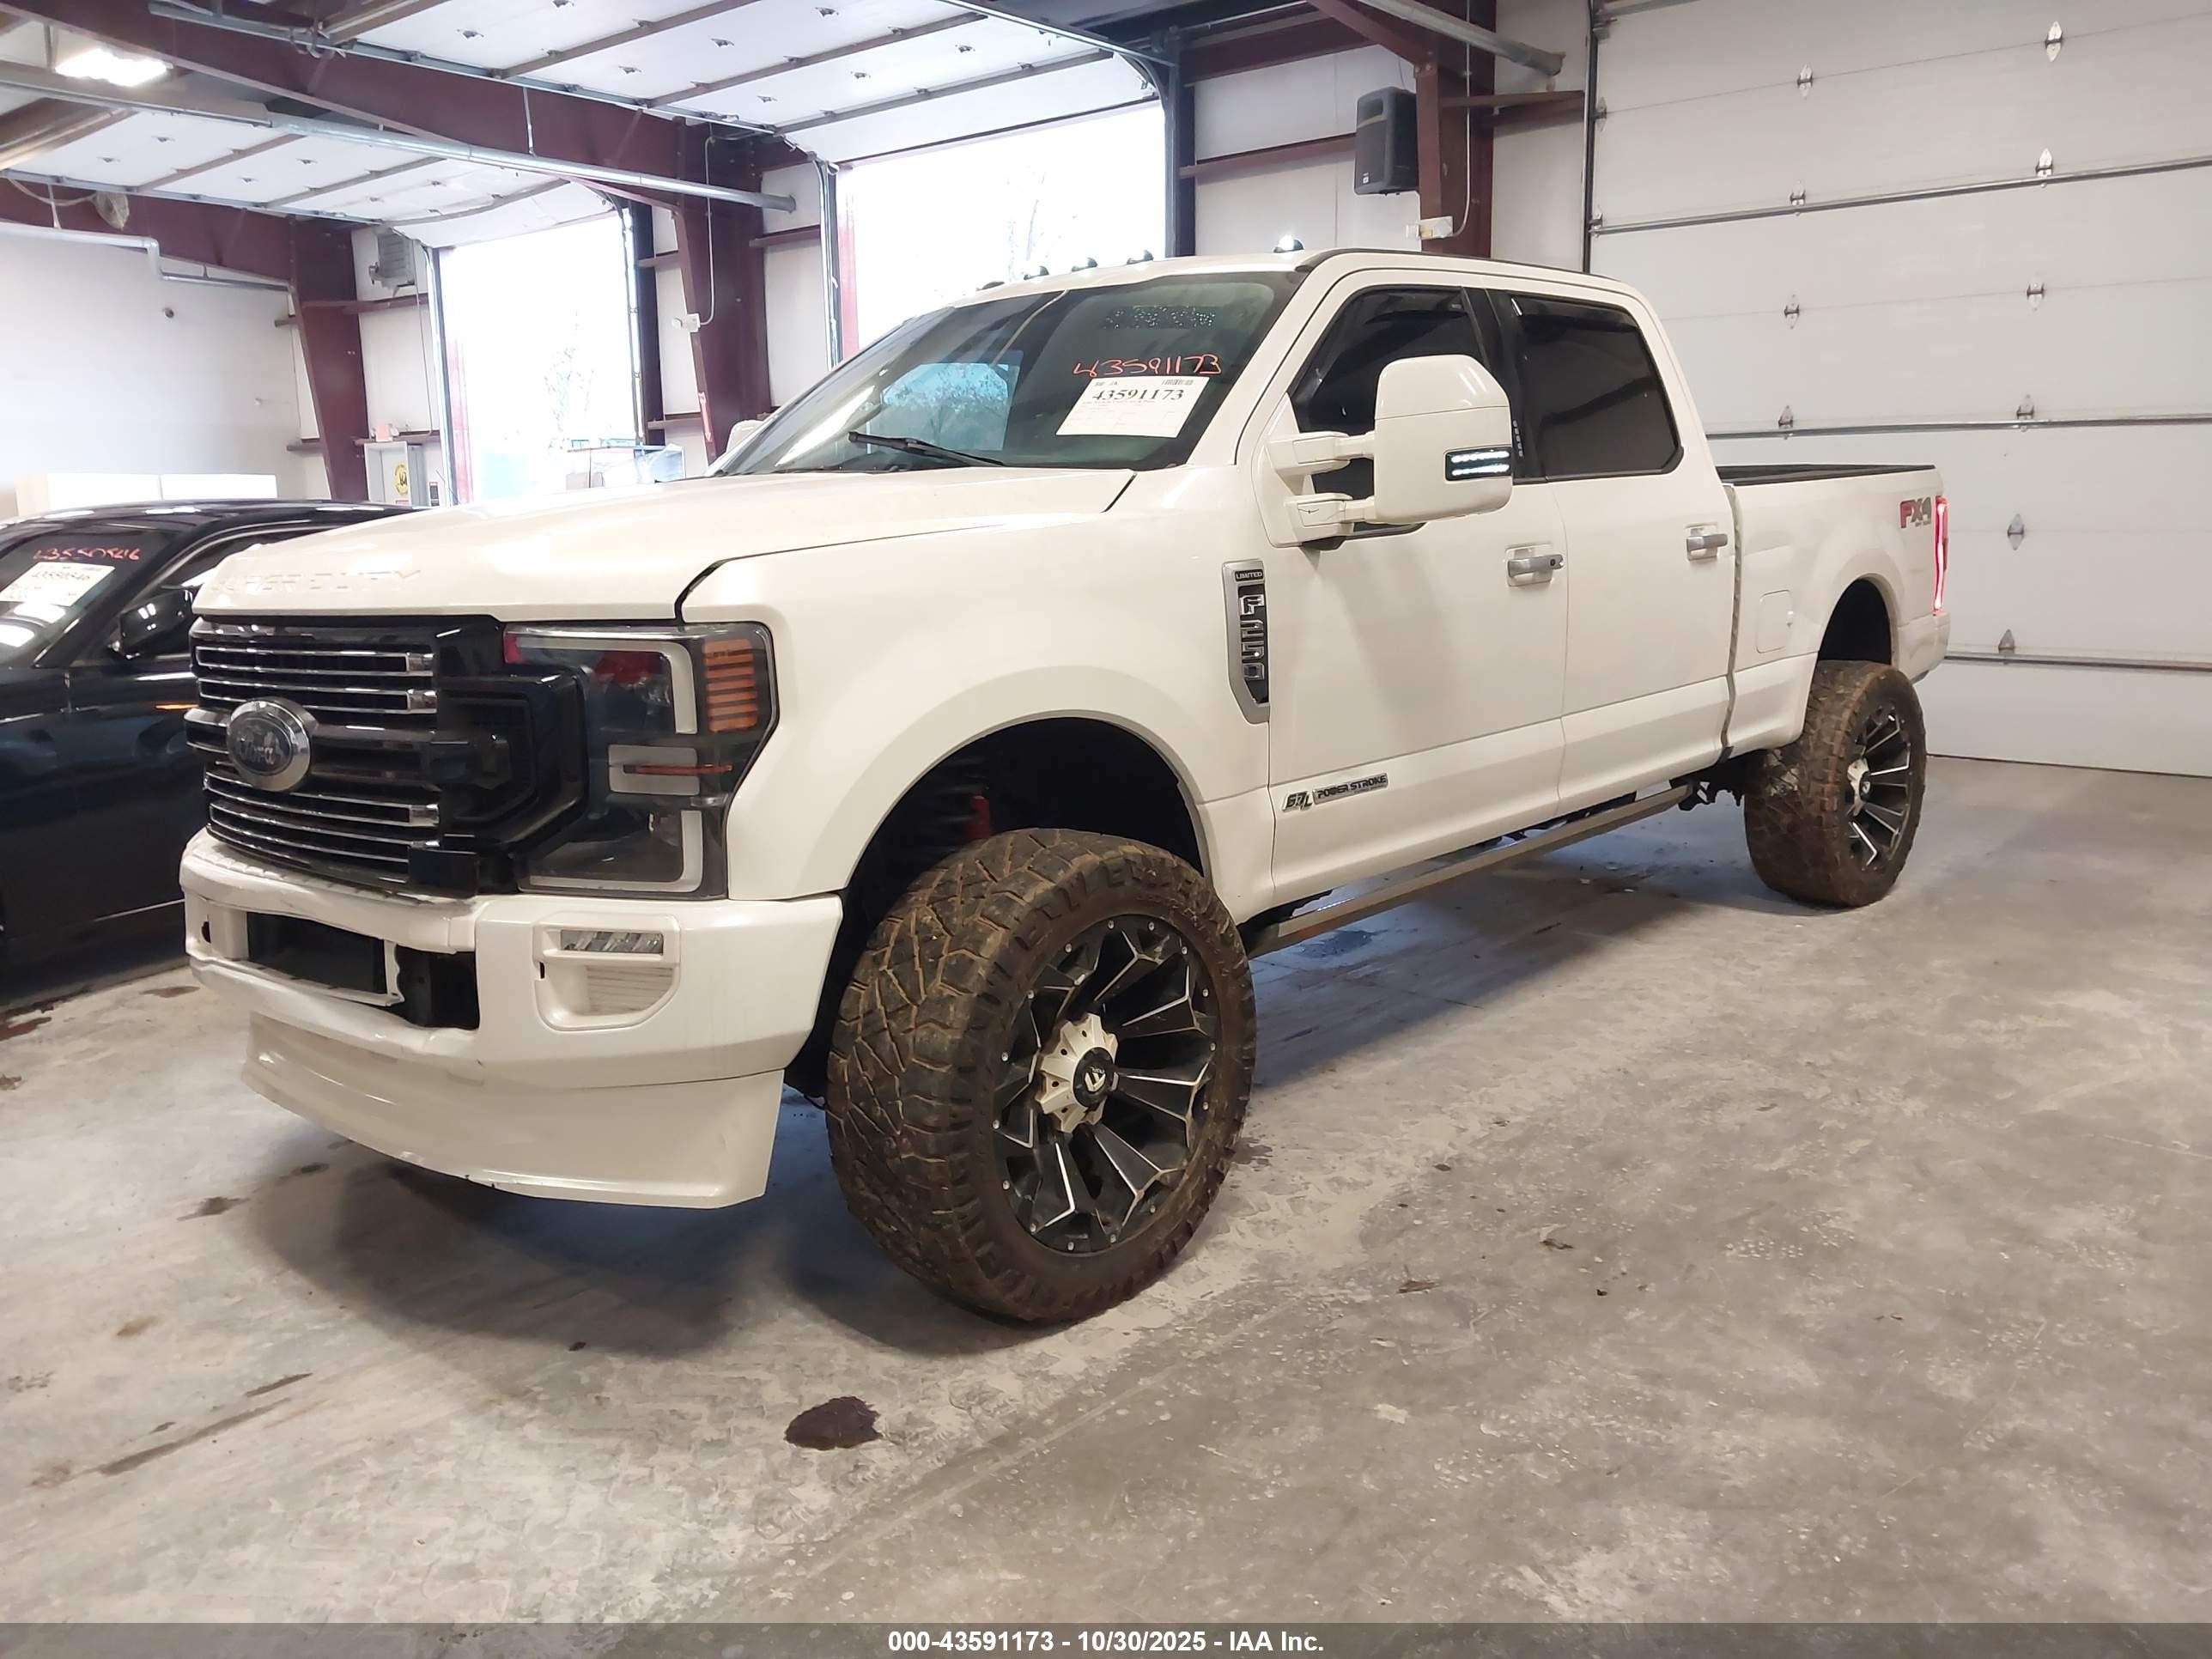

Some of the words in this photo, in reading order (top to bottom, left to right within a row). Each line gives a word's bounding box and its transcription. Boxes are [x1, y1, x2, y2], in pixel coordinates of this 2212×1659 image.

[1073, 354, 1222, 378] 43591173
[1092, 388, 1185, 401] 43591173
[1899, 496, 1932, 528] FX4
[1237, 570, 1263, 580] LIMITED
[1350, 775, 1387, 791] STROKE
